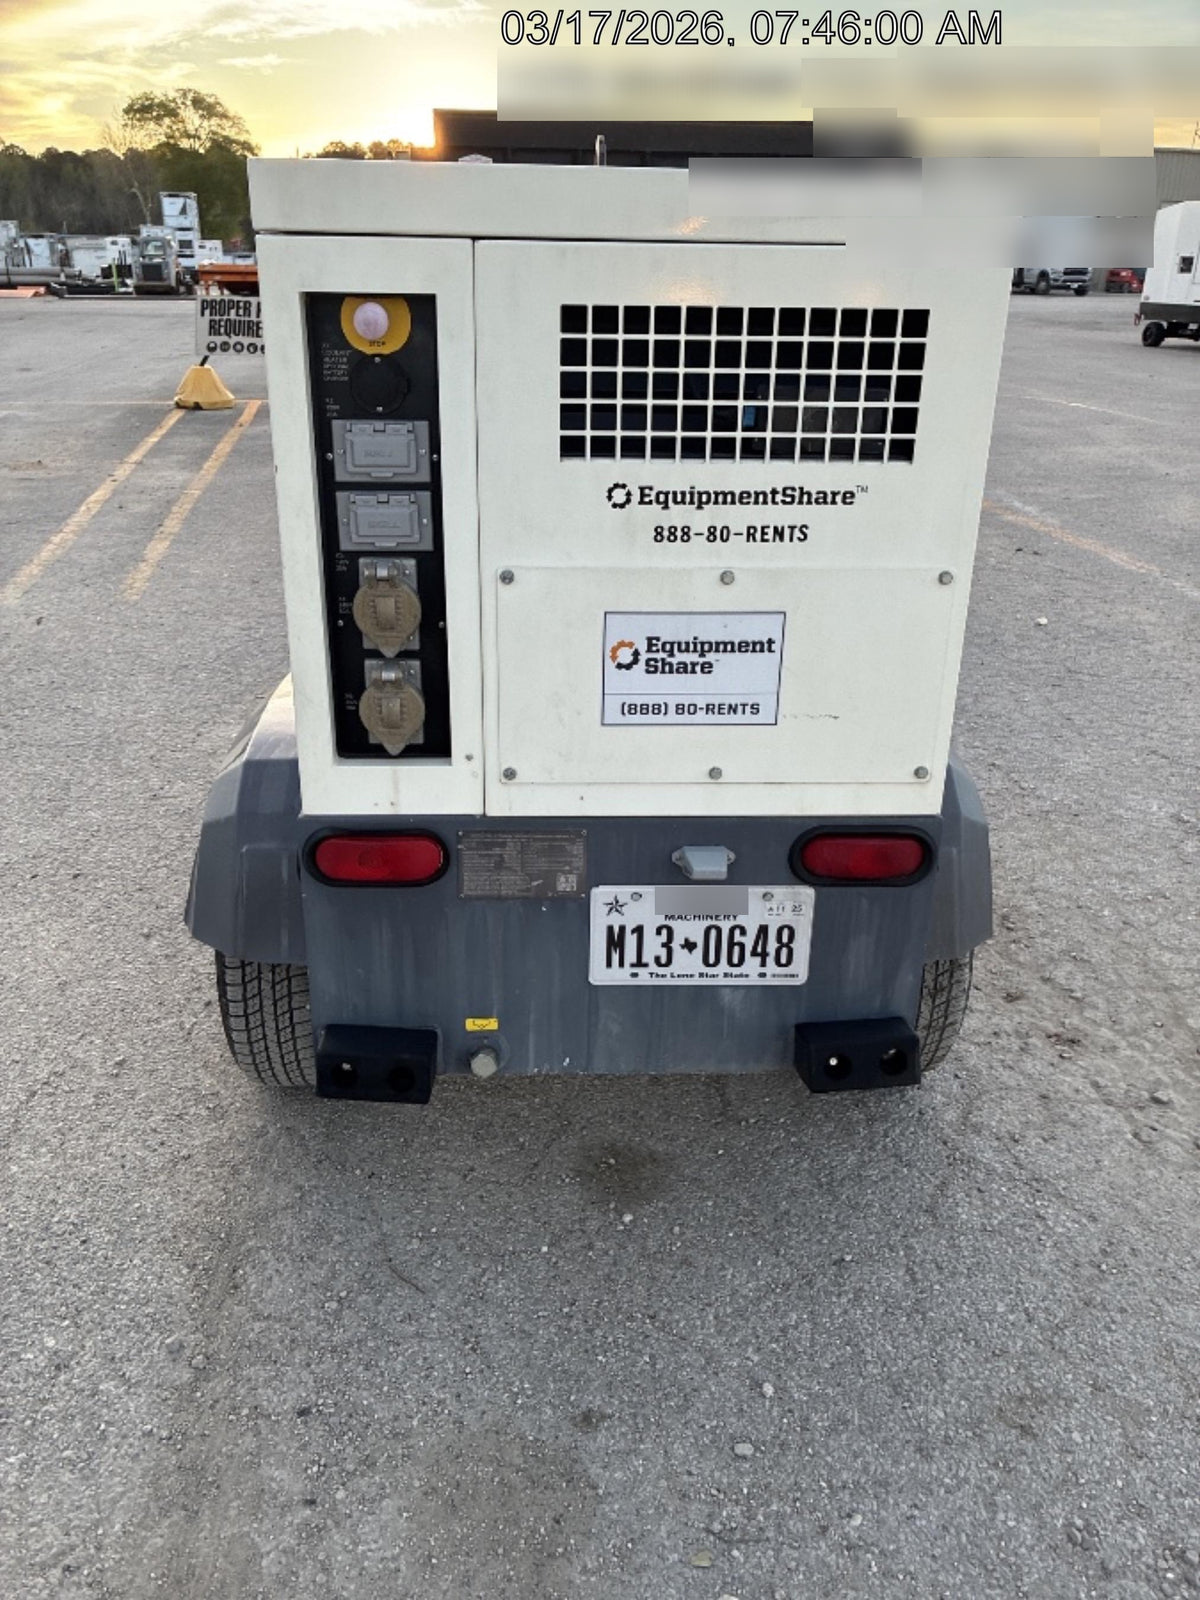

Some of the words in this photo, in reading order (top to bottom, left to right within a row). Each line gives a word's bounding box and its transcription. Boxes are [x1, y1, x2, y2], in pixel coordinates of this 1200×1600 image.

[201, 298, 252, 318] PROPER
[208, 318, 263, 338] REQUIRE
[653, 524, 809, 543] 888-80-RENTS
[645, 636, 776, 657] Equipment
[644, 658, 714, 675] Share
[621, 703, 668, 716] (888)
[675, 703, 760, 716] 80-RENTS
[606, 924, 674, 968] M13
[702, 924, 796, 968] 0648
